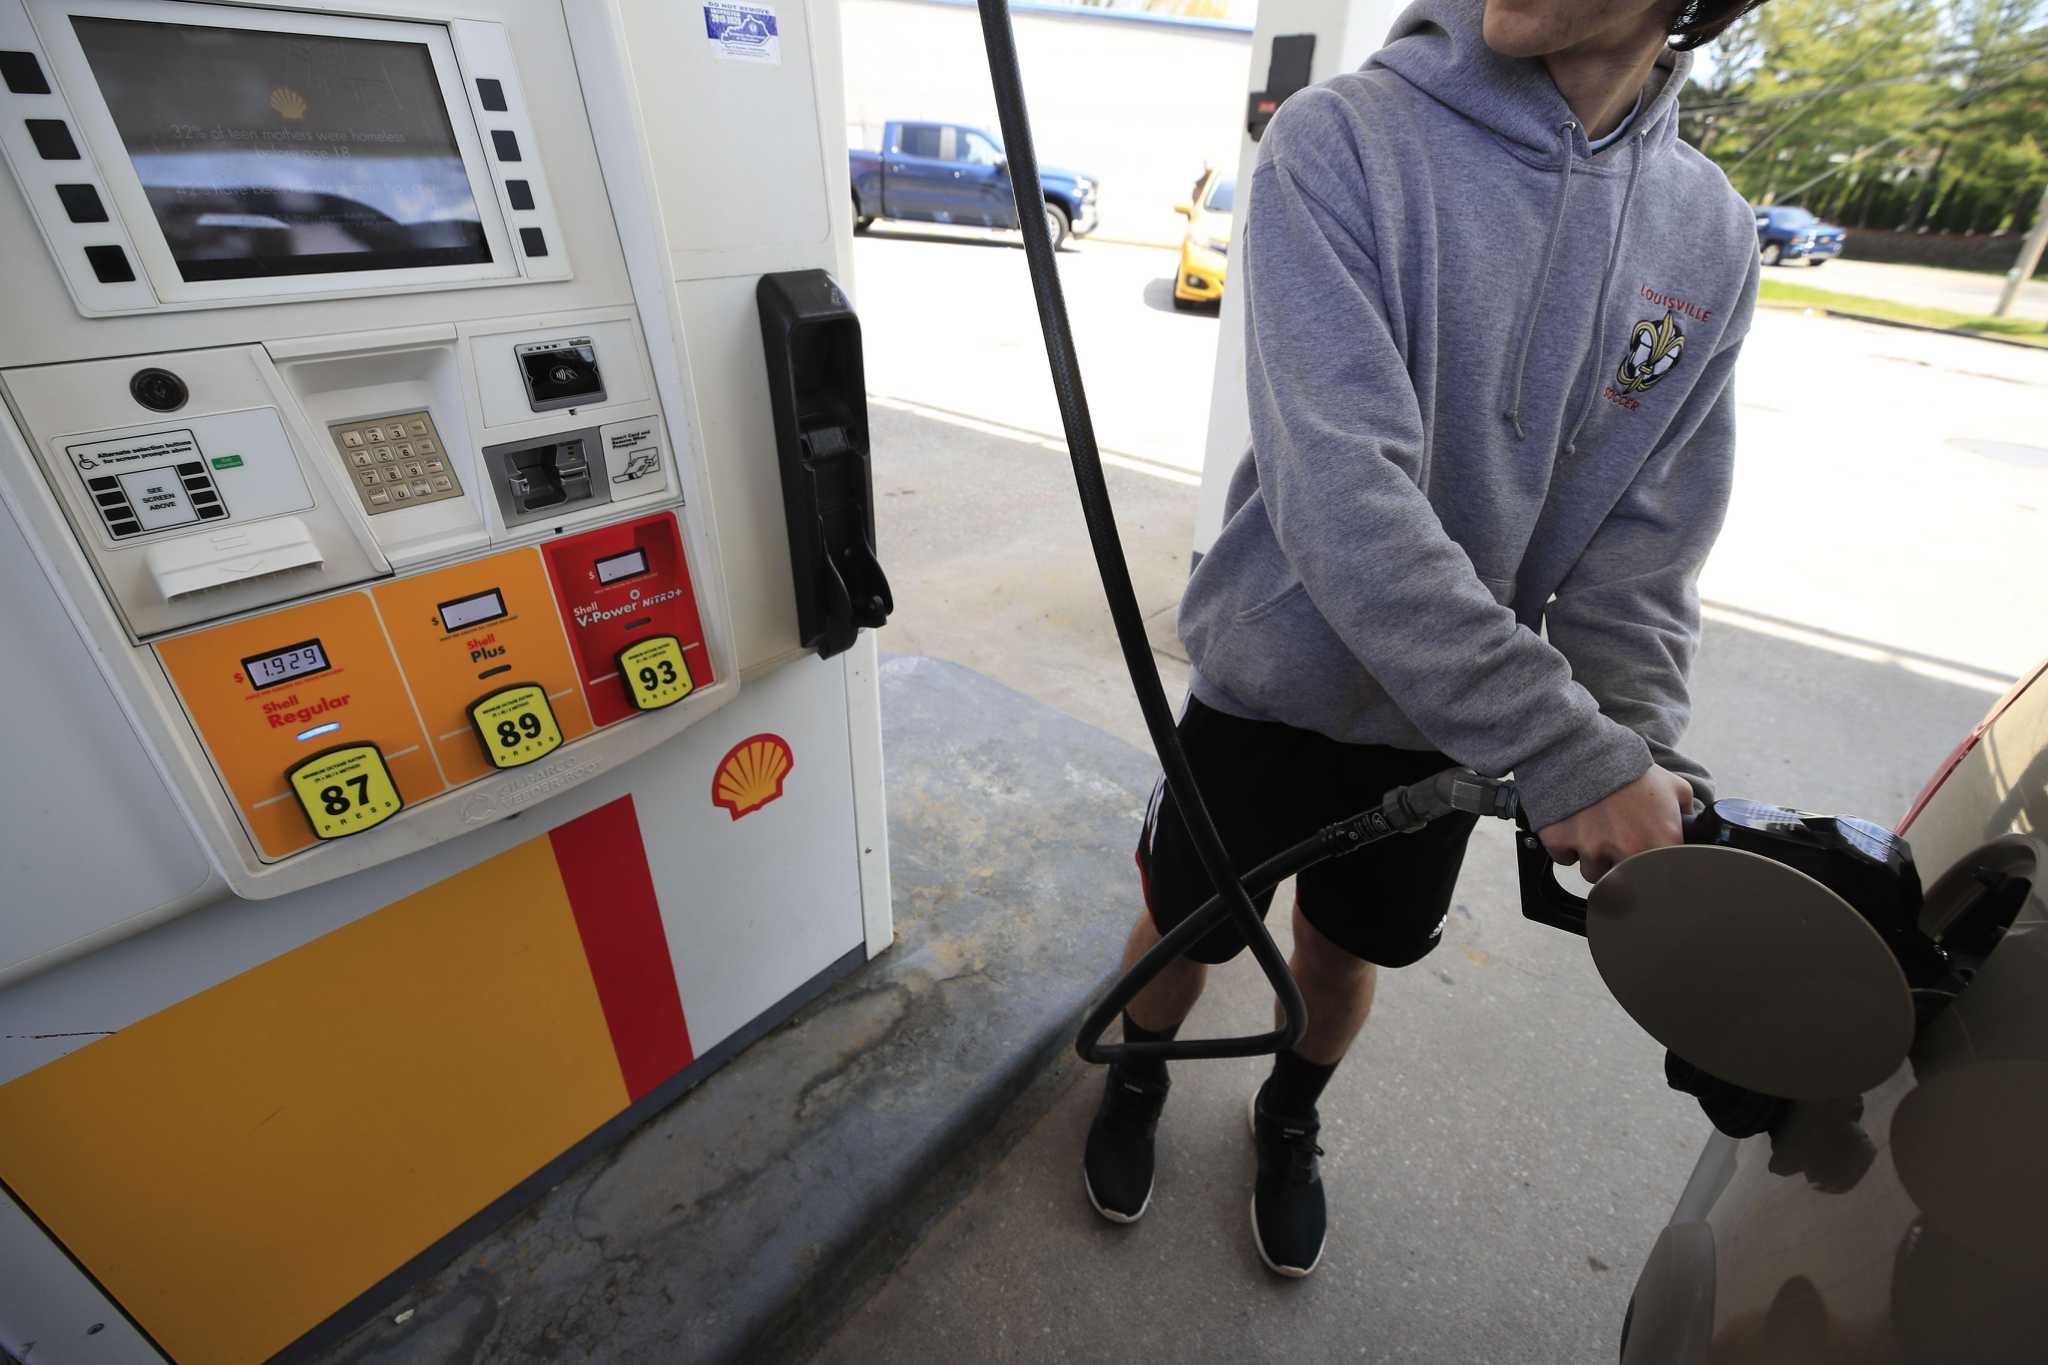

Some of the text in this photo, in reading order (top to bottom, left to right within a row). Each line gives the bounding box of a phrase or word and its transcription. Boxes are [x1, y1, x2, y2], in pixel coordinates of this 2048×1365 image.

[262, 127, 313, 143] mothers
[315, 130, 350, 143] were
[350, 128, 405, 144] homeless
[333, 145, 351, 160] 18
[1640, 284, 1712, 322] LOUISVILLE
[371, 433, 380, 442] 2
[393, 430, 401, 438] 3
[97, 440, 192, 459] Alternate selection buttons
[115, 455, 140, 463] screen
[141, 450, 170, 460] prompts
[172, 446, 192, 454] above
[402, 448, 410, 457] 6
[410, 467, 418, 475] 9
[367, 476, 374, 484] 7
[142, 493, 176, 504] SCREEN
[146, 486, 164, 495] SEE
[149, 502, 177, 512] ABOVE
[573, 601, 599, 617] Shell
[576, 602, 638, 628] V-Power
[467, 633, 496, 650] Shell
[262, 648, 317, 677] 1.929
[470, 645, 506, 664] Plus
[639, 660, 677, 692] 93
[262, 694, 300, 714] Shell
[266, 694, 351, 728] Regular
[497, 712, 542, 747] 89
[320, 773, 370, 816] 87
[324, 800, 392, 832] PRESS
